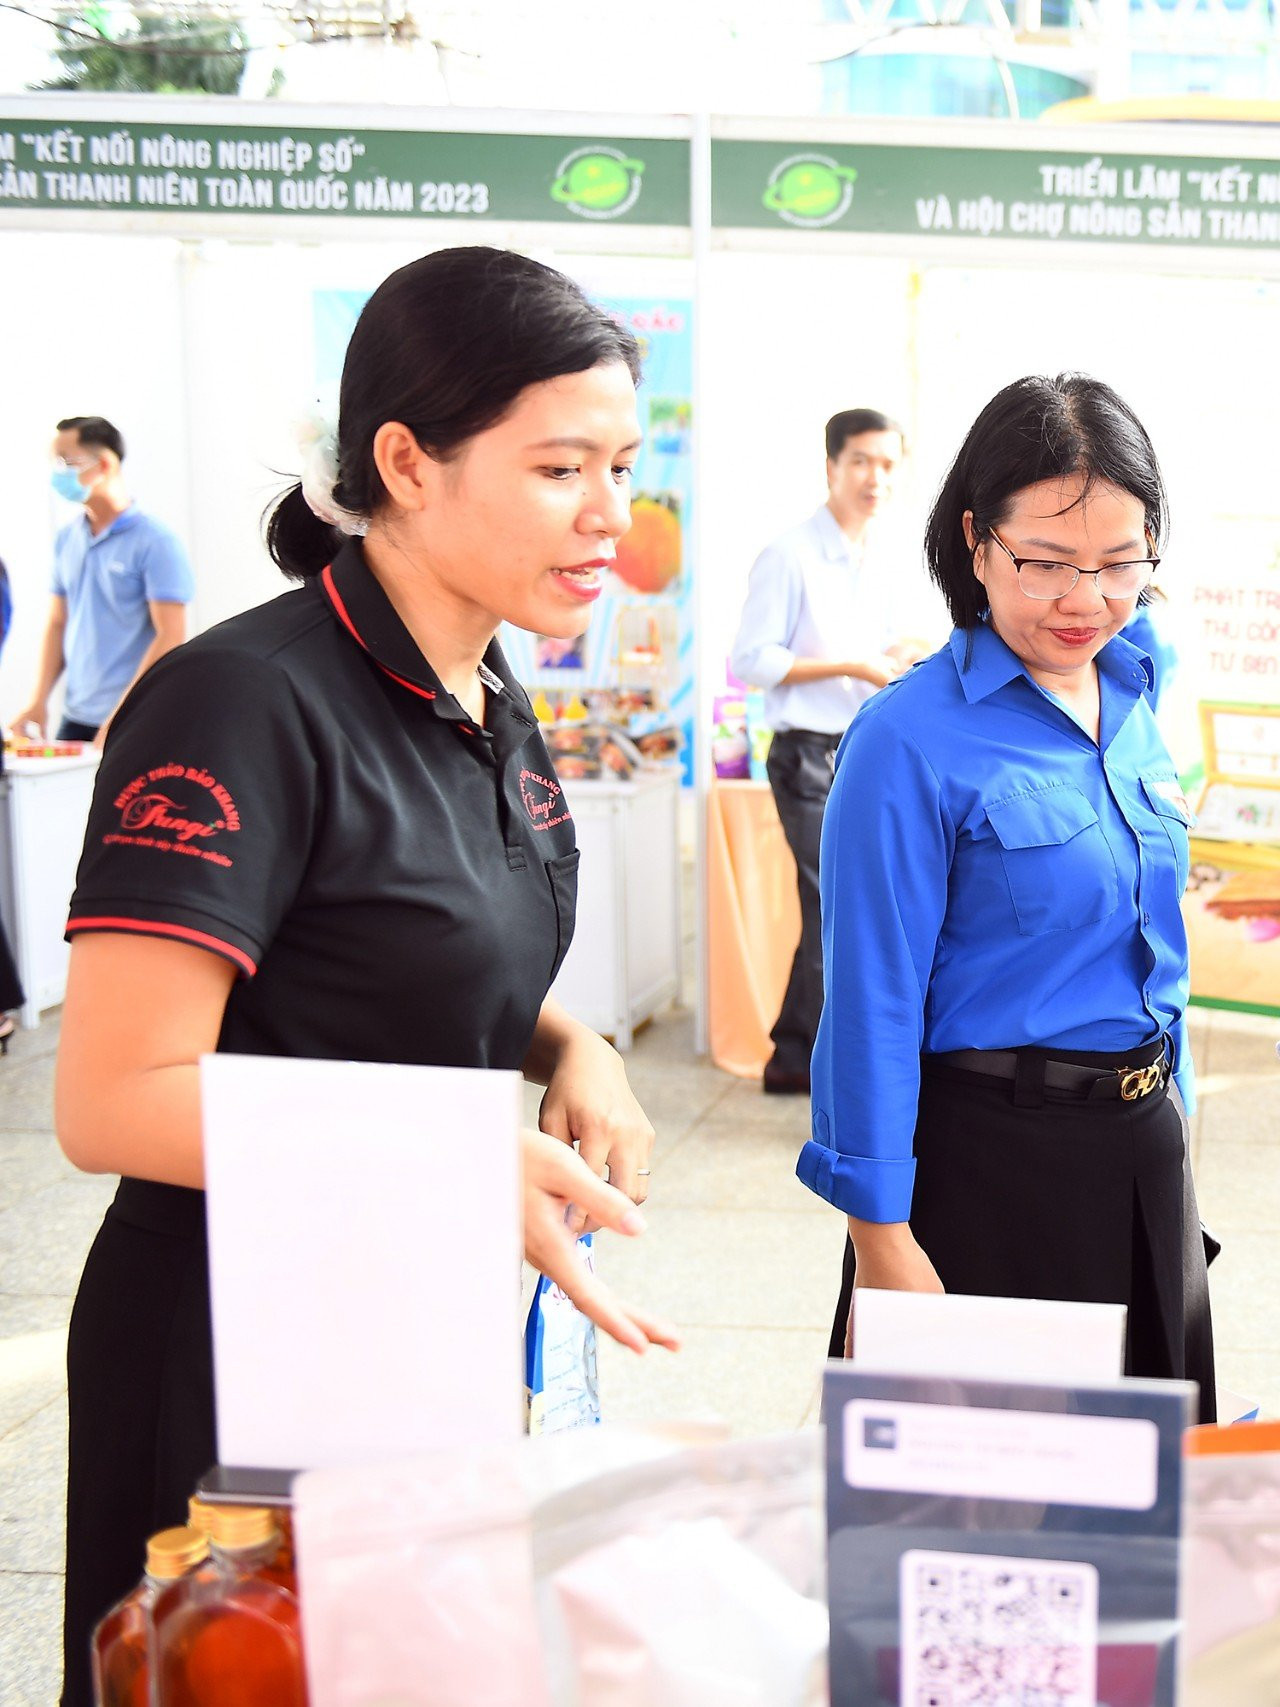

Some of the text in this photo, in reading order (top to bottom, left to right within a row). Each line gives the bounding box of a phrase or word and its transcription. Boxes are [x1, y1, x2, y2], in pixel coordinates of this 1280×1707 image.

[21, 127, 84, 164] "KẾT
[90, 130, 135, 167] NỐI
[141, 132, 212, 169] NÔNG
[218, 137, 312, 176] NGHIỆP
[318, 136, 366, 173] SỐ"
[0, 164, 489, 213] ẢN THANH NIÊN TOÀN QUỐC NĂM 2023
[1039, 158, 1118, 198] TRIỂN
[1187, 165, 1253, 203] "KẾT
[916, 194, 953, 230] VÀ
[958, 195, 1004, 236] HỘI
[1009, 201, 1066, 238] CHỢ
[1069, 201, 1142, 237] NÔNG
[1147, 201, 1201, 239] SẢN
[531, 772, 561, 795] KHANG
